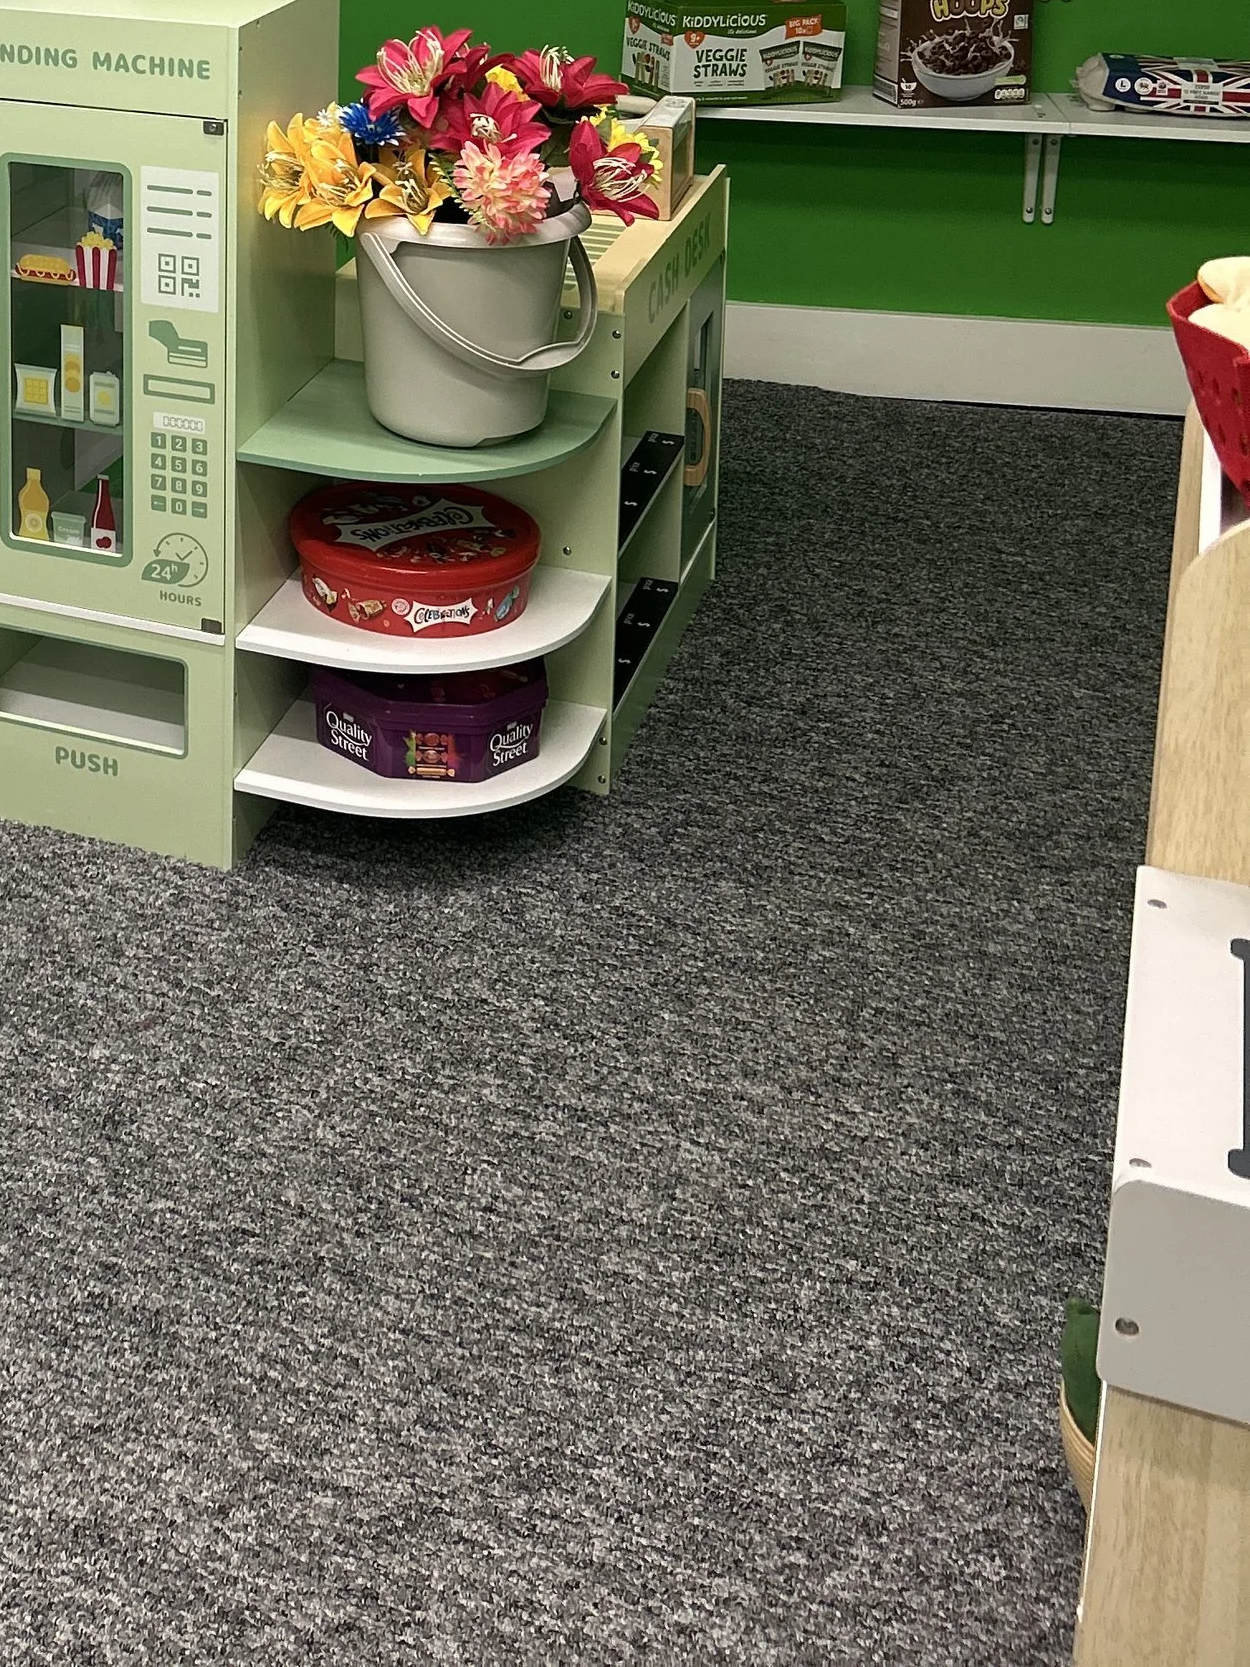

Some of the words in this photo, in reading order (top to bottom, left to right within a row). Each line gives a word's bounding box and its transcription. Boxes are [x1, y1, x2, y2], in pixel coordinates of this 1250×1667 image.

[626, 36, 647, 51] VEGGIE
[649, 42, 670, 61] STRAWS
[696, 48, 747, 63] VEGGIE
[92, 51, 211, 80] MACHINE
[693, 63, 748, 78] STRAWS
[1120, 80, 1126, 88] L
[900, 98, 917, 107] 500g
[648, 253, 679, 324] CASH
[684, 212, 711, 278] DESK
[155, 435, 161, 446] 1
[175, 438, 183, 450] 2
[196, 441, 203, 453] 3
[154, 456, 163, 467] 4
[175, 459, 182, 470] 5
[196, 462, 203, 474] 6
[155, 477, 162, 488] 7
[175, 480, 183, 491] 8
[196, 483, 203, 495] 9
[175, 501, 182, 513] 0
[159, 590, 202, 607] HOURS
[326, 711, 372, 747] Quality
[490, 723, 533, 752] Quality
[331, 730, 370, 762] Street
[492, 741, 528, 767] Street
[55, 746, 118, 777] PUSH
